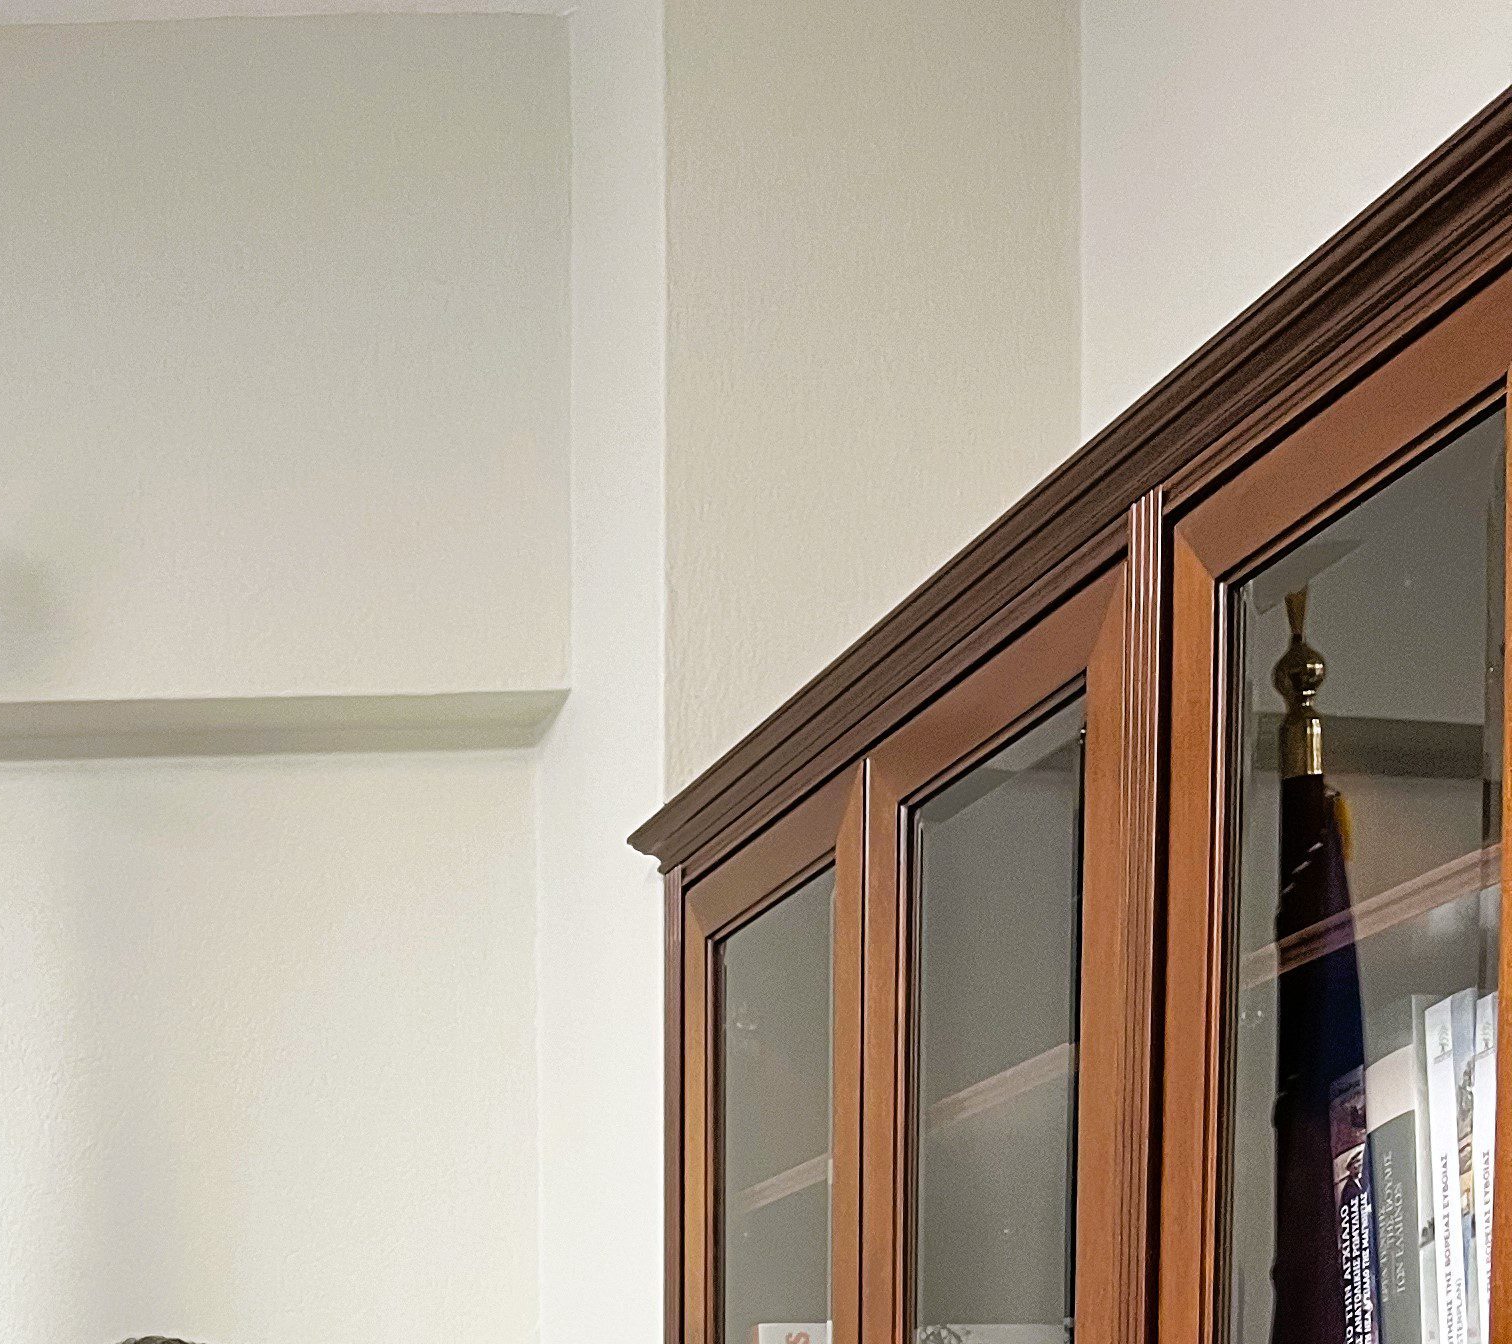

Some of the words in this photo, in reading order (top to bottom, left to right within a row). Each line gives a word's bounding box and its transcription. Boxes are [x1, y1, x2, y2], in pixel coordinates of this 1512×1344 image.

[1339, 1204, 1352, 1280] ΑΓΧΙΑΛΟ
[1443, 1271, 1453, 1296] ΤΗΣ
[1343, 1284, 1354, 1324] ΤΗΝ
